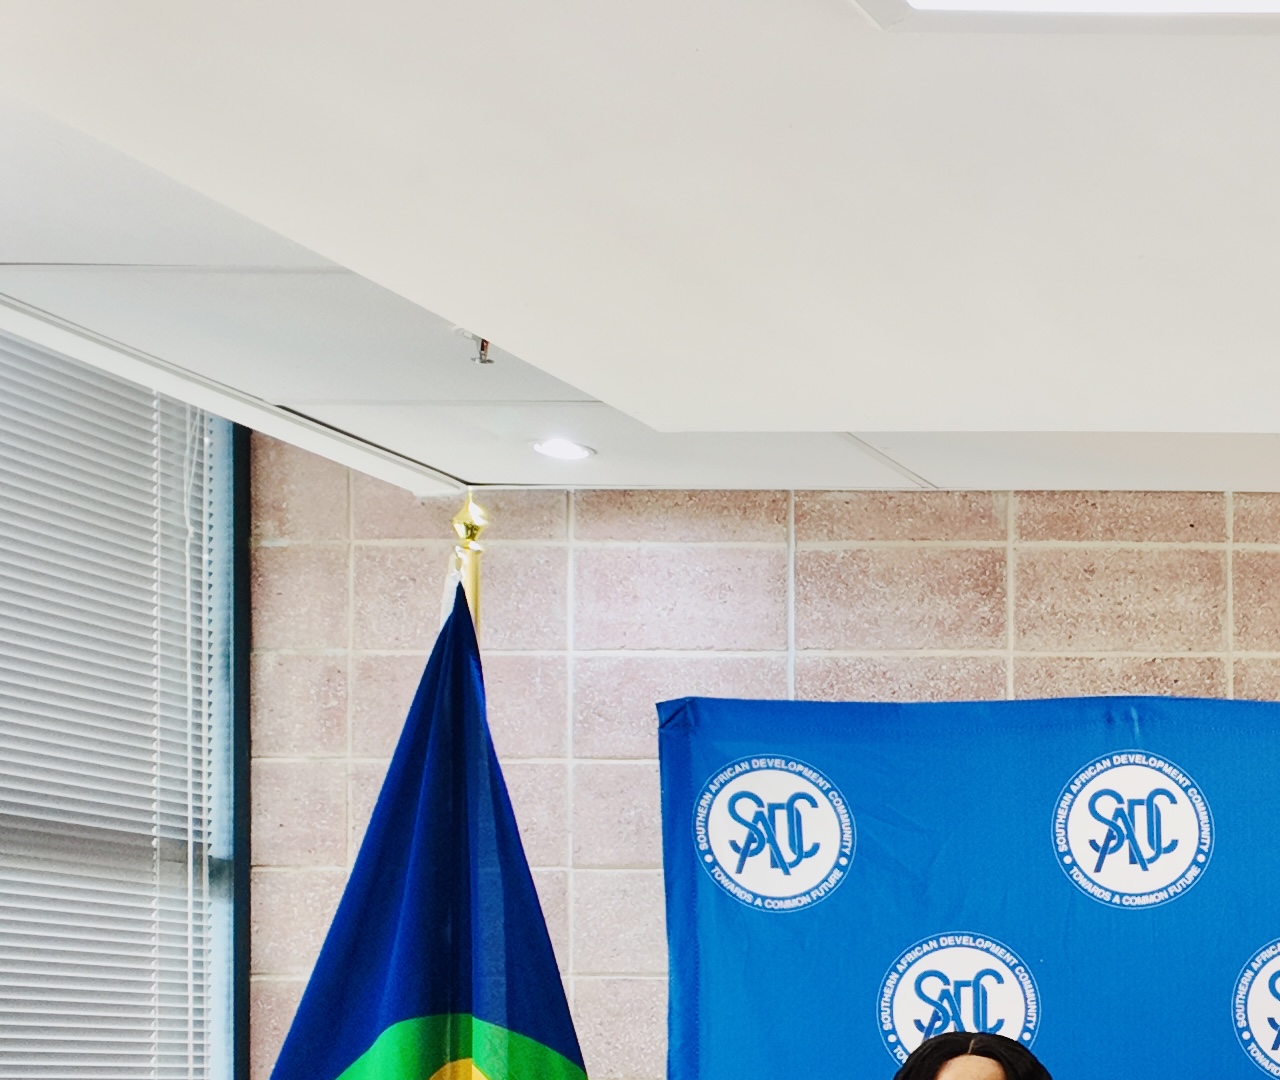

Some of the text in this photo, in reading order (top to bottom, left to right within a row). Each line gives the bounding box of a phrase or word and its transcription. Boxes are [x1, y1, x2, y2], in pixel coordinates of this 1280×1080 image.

[695, 758, 853, 856] SOUTHERN AFRICAN DEVELOPMENT COMMUNITY
[1055, 755, 1211, 851] SOUTHERN AFRICAN DEVELOPMENT COMMUNITY
[710, 865, 755, 904] TOWARDS
[764, 894, 813, 910] COMMON
[811, 868, 844, 901] FUTURE
[1069, 864, 1113, 902] TOWARDS
[1121, 890, 1170, 907] COMMON
[1168, 863, 1201, 897] FUTURE
[880, 935, 1038, 1031] SOUTHERN AFRICAN DEVELOPMENT COMMUNITY
